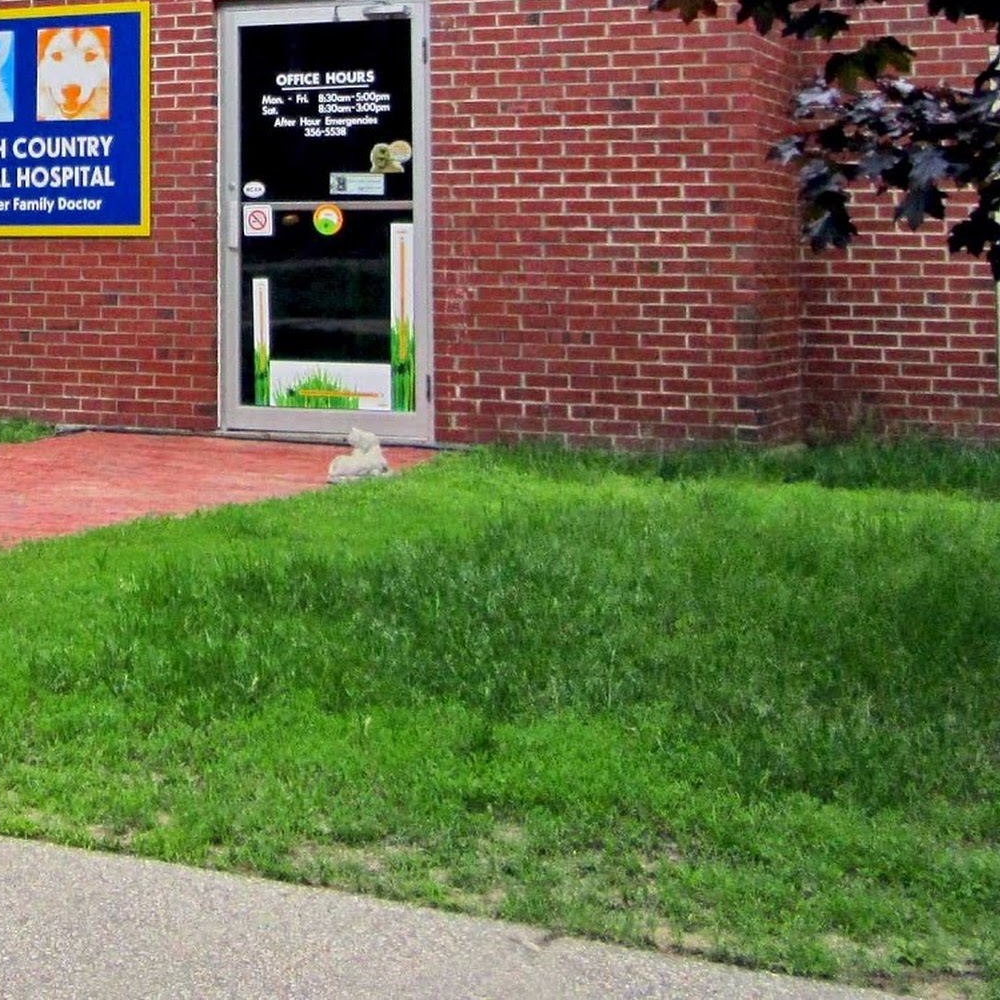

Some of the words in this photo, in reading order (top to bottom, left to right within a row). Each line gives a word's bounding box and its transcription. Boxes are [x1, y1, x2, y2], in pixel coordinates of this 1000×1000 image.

[276, 72, 320, 86] OFFICE
[325, 70, 375, 84] HOURS
[261, 95, 284, 105] Mon.
[261, 105, 279, 115] Sat.
[273, 117, 296, 127] After
[300, 116, 321, 127] Hour
[325, 115, 378, 128] Emergencies
[304, 127, 347, 137] 356-5538
[12, 135, 113, 159] COUNTRY
[16, 165, 115, 188] HOSPITAL
[13, 197, 55, 214] Family
[58, 197, 102, 211] Doctor
